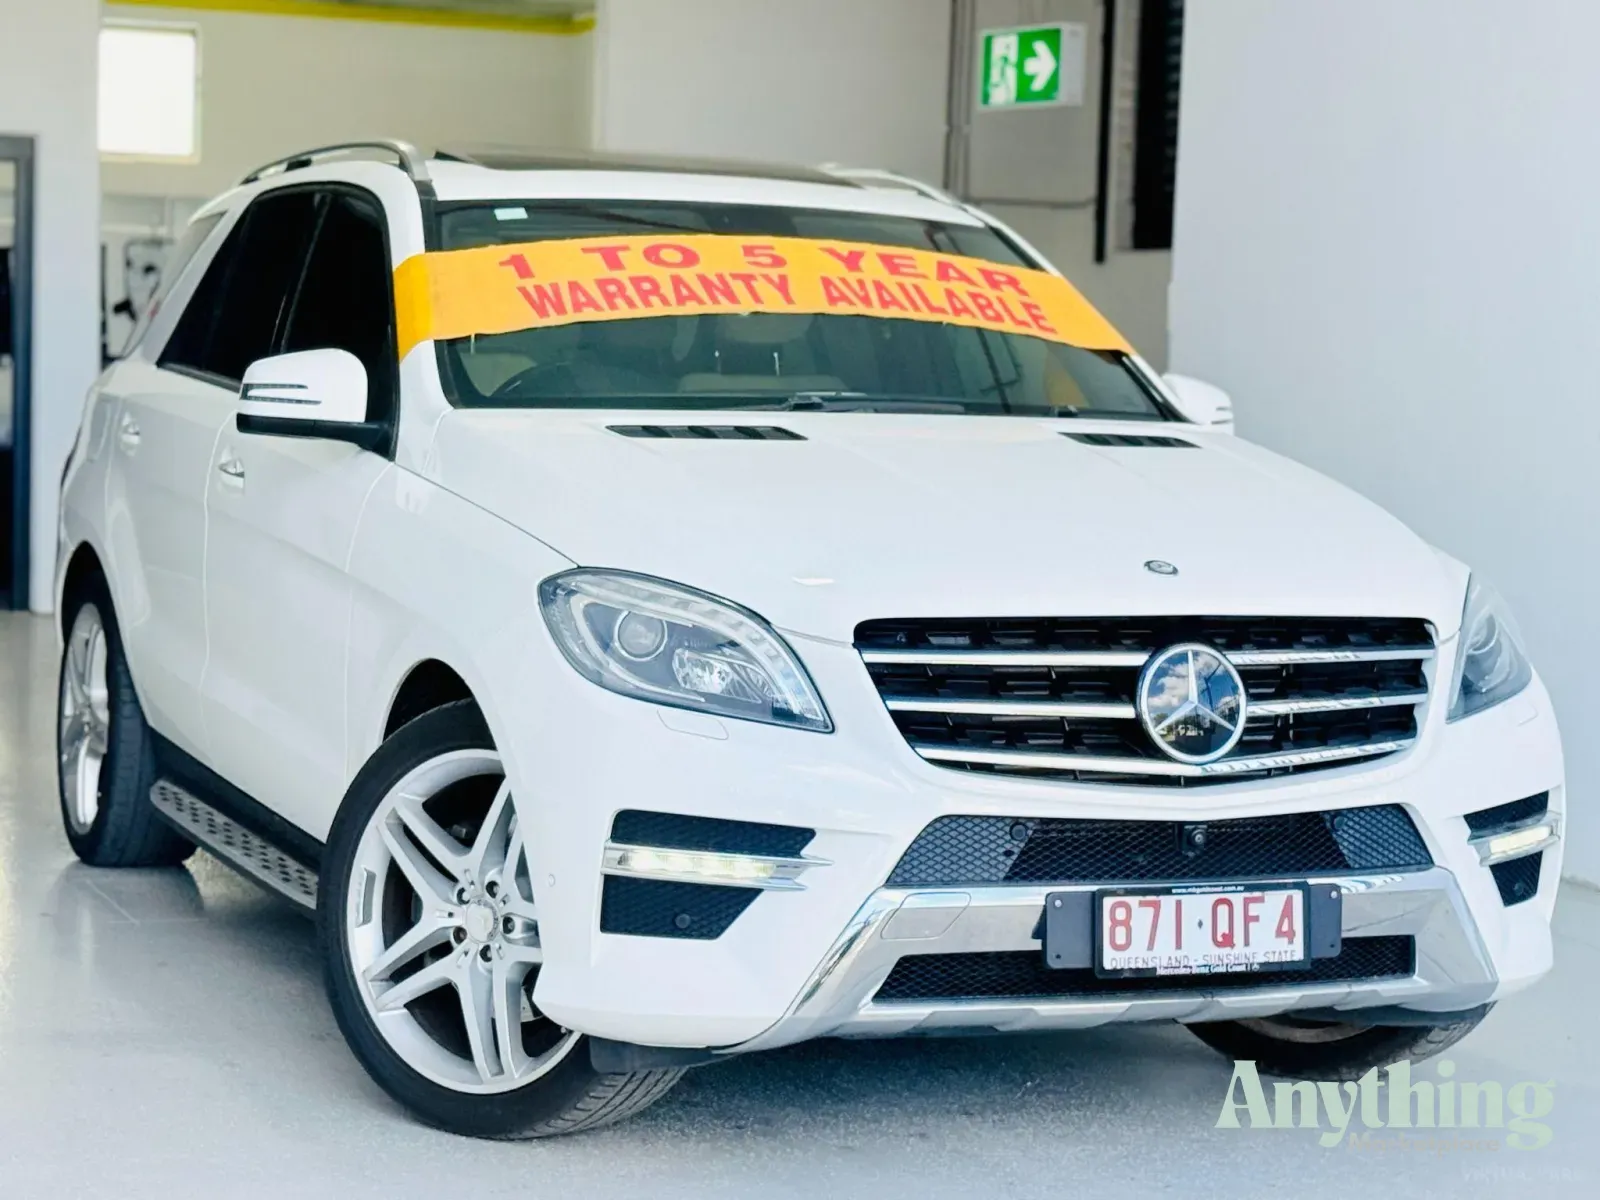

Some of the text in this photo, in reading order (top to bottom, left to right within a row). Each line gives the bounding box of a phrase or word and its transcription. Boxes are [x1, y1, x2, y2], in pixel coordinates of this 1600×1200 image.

[499, 244, 1030, 297] 1 TO 5 YEAR
[516, 272, 1058, 334] WARRANTY AVAILABLE
[1109, 899, 1182, 951] 871
[1110, 954, 1190, 969] QUEENSLAND
[1202, 951, 1258, 966] SUNSHINE
[1263, 950, 1297, 963] STATE
